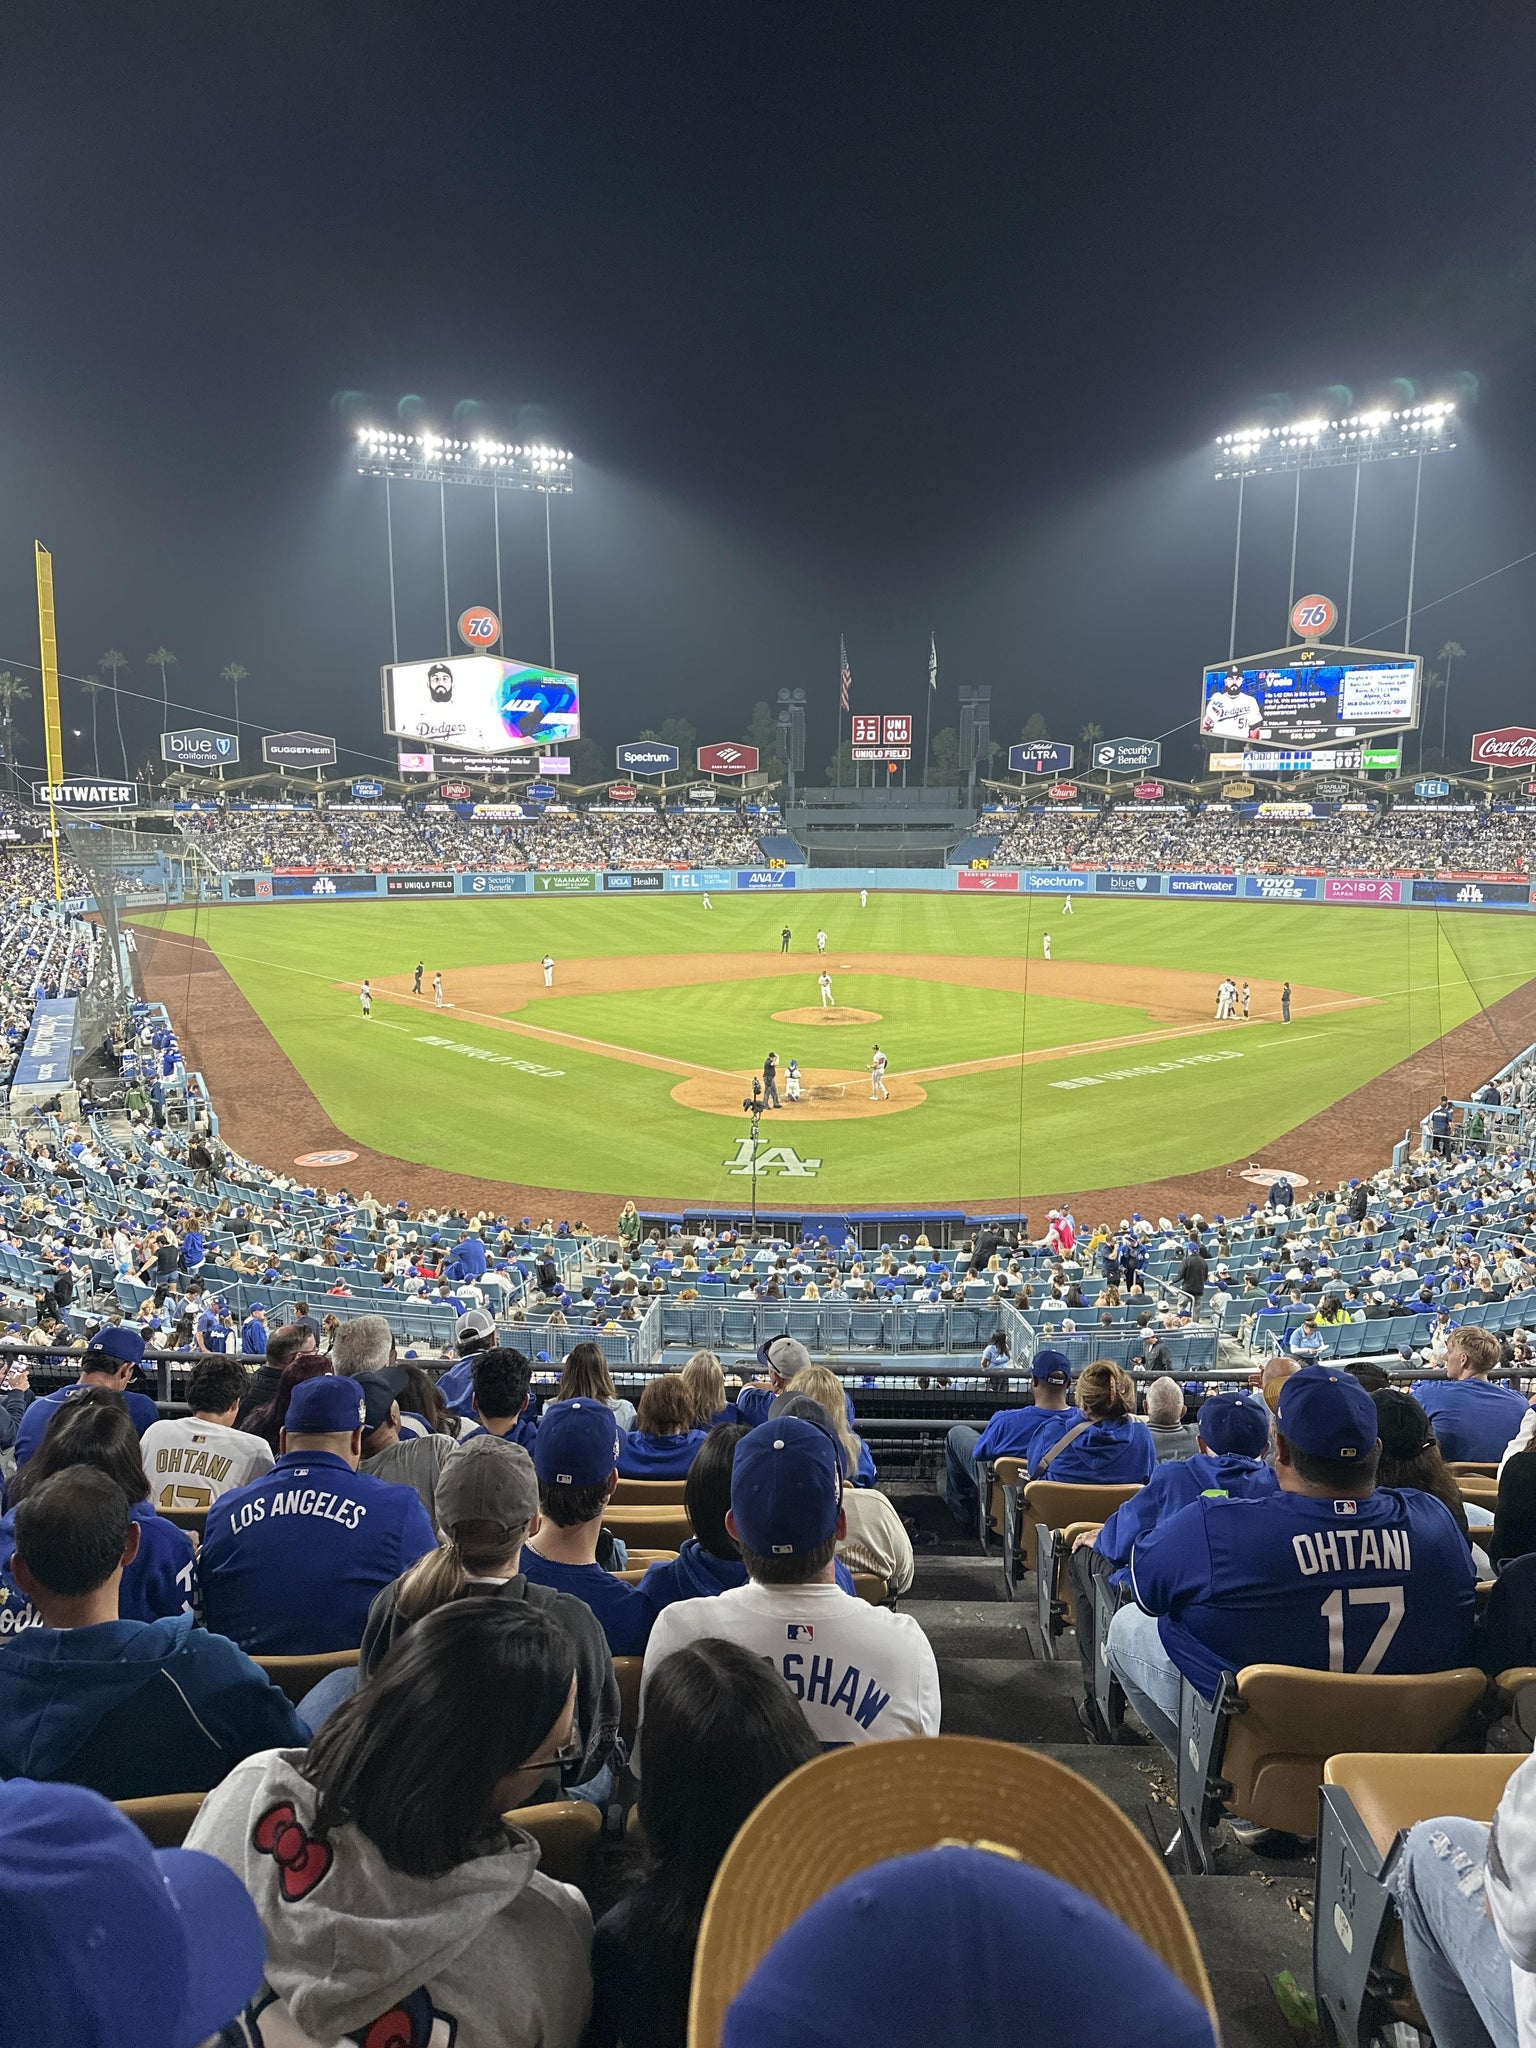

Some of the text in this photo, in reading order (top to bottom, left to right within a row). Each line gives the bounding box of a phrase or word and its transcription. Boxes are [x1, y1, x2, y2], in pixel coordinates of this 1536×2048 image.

[1299, 604, 1326, 627] 76
[469, 617, 494, 637] 76
[887, 720, 906, 730] UNI
[416, 722, 467, 741] Dodgers
[887, 730, 908, 741] QLO
[171, 736, 212, 752] blue
[271, 746, 330, 754] GUGGENHEIM
[855, 750, 908, 760] UNIQLO FIELD
[1118, 745, 1153, 756] Security
[178, 751, 217, 760] california
[624, 752, 669, 763] Spectrum
[1022, 751, 1058, 760] ULTRA
[1118, 755, 1147, 764] Benefit
[1353, 756, 1360, 768] 2
[447, 786, 466, 795] JINRO
[1050, 787, 1076, 797] Churu
[1419, 783, 1445, 795] TEL
[770, 859, 786, 868] 0:24
[972, 859, 989, 869] 0:24
[488, 876, 515, 885] Security
[611, 877, 659, 886] UCLA Health
[672, 874, 699, 887] TEL
[749, 873, 772, 883] ANA
[1029, 876, 1081, 888] Spectrum
[1110, 877, 1135, 887] blue
[1256, 878, 1295, 888] TOYO
[258, 884, 269, 892] 76
[404, 881, 452, 890] UNIQLO FIELD
[1172, 880, 1233, 891] smartwater
[1332, 882, 1376, 892] DAISO
[1261, 887, 1304, 897] TIRES
[444, 1043, 566, 1077] UNIQLO FIELD
[1095, 1050, 1245, 1080] UNIQLO FIELD
[722, 1138, 823, 1177] LA
[156, 1448, 233, 1482] OHTANI
[230, 1489, 367, 1535] LOS ANGELES
[1292, 1529, 1411, 1576] OHTANI
[1321, 1585, 1405, 1674] 17
